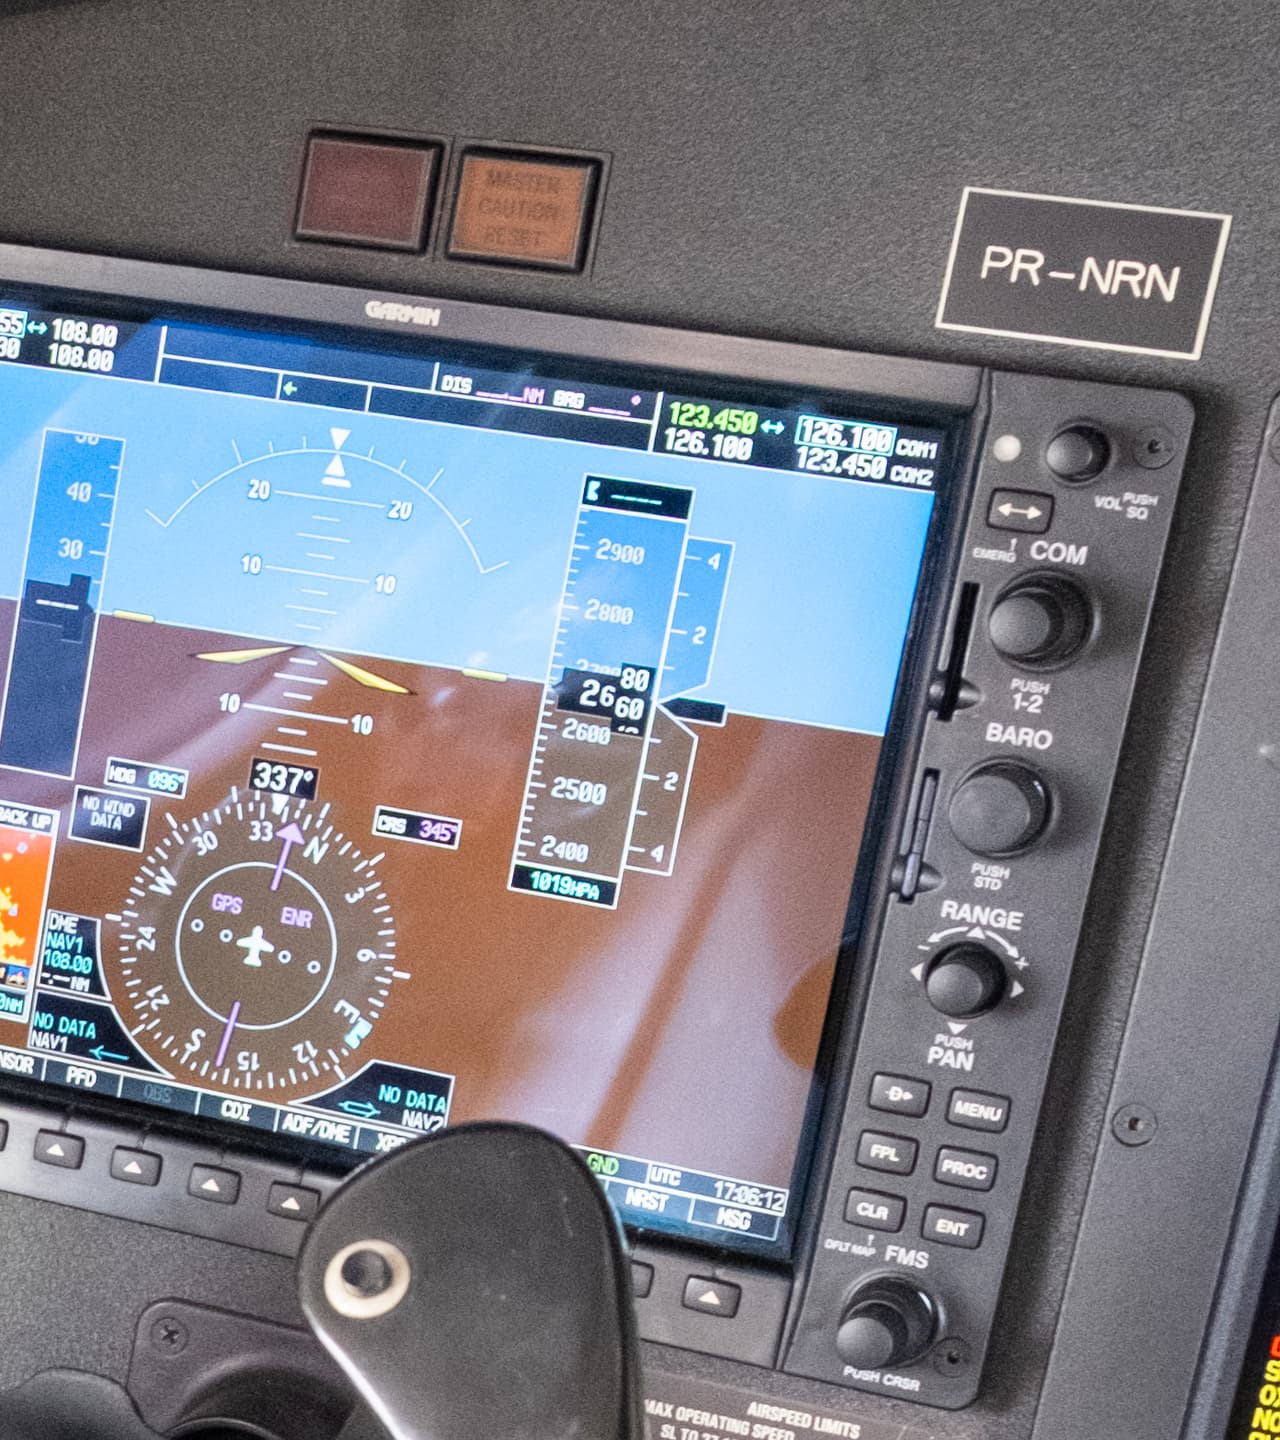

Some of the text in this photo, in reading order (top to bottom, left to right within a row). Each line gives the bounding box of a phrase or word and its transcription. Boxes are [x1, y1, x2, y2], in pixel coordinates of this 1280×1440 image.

[365, 300, 441, 326] GARMIN
[52, 319, 118, 348] 108.00
[48, 344, 114, 372] 108.00
[441, 375, 473, 395] DIS
[669, 402, 938, 460] 123.450 126.100 COM1
[665, 428, 934, 487] 126.100 123.450 COM2
[595, 539, 645, 566] 2900
[1029, 540, 1088, 566] COM
[584, 600, 634, 626] 2800
[1010, 677, 1051, 695] PUSH
[1012, 694, 1043, 714] 1-2
[561, 718, 612, 746] 2600
[984, 722, 1054, 750] BARO
[108, 764, 136, 786] HDG
[550, 778, 607, 806] 2500
[31, 811, 52, 831] UP
[376, 814, 407, 834] CRS
[970, 862, 1011, 880] PUSH
[974, 875, 1003, 892] STD
[211, 892, 243, 915] GPS
[940, 900, 1024, 931] RANGE
[48, 914, 78, 935] DME
[280, 906, 314, 929] ENR
[46, 932, 83, 954] NAV1
[44, 949, 92, 975] 108.00
[935, 1033, 974, 1052] PUSH
[927, 1046, 975, 1072] PAN
[65, 1065, 97, 1089] PFD
[220, 1100, 252, 1122] CDI
[282, 1112, 351, 1144] ADF/DME
[954, 1100, 1003, 1122] MENU
[869, 1143, 900, 1162] FPL
[941, 1157, 988, 1181] PROC
[625, 1187, 668, 1212] NRST
[651, 1165, 784, 1212] UTC 17:06:12
[856, 1201, 889, 1221] CLR
[935, 1218, 969, 1238] ENT
[884, 1244, 930, 1270] FMS
[842, 1364, 921, 1392] PUSH CRSR
[661, 1424, 678, 1440] SL
[747, 1401, 861, 1439] AIRSPEED LIMITS
